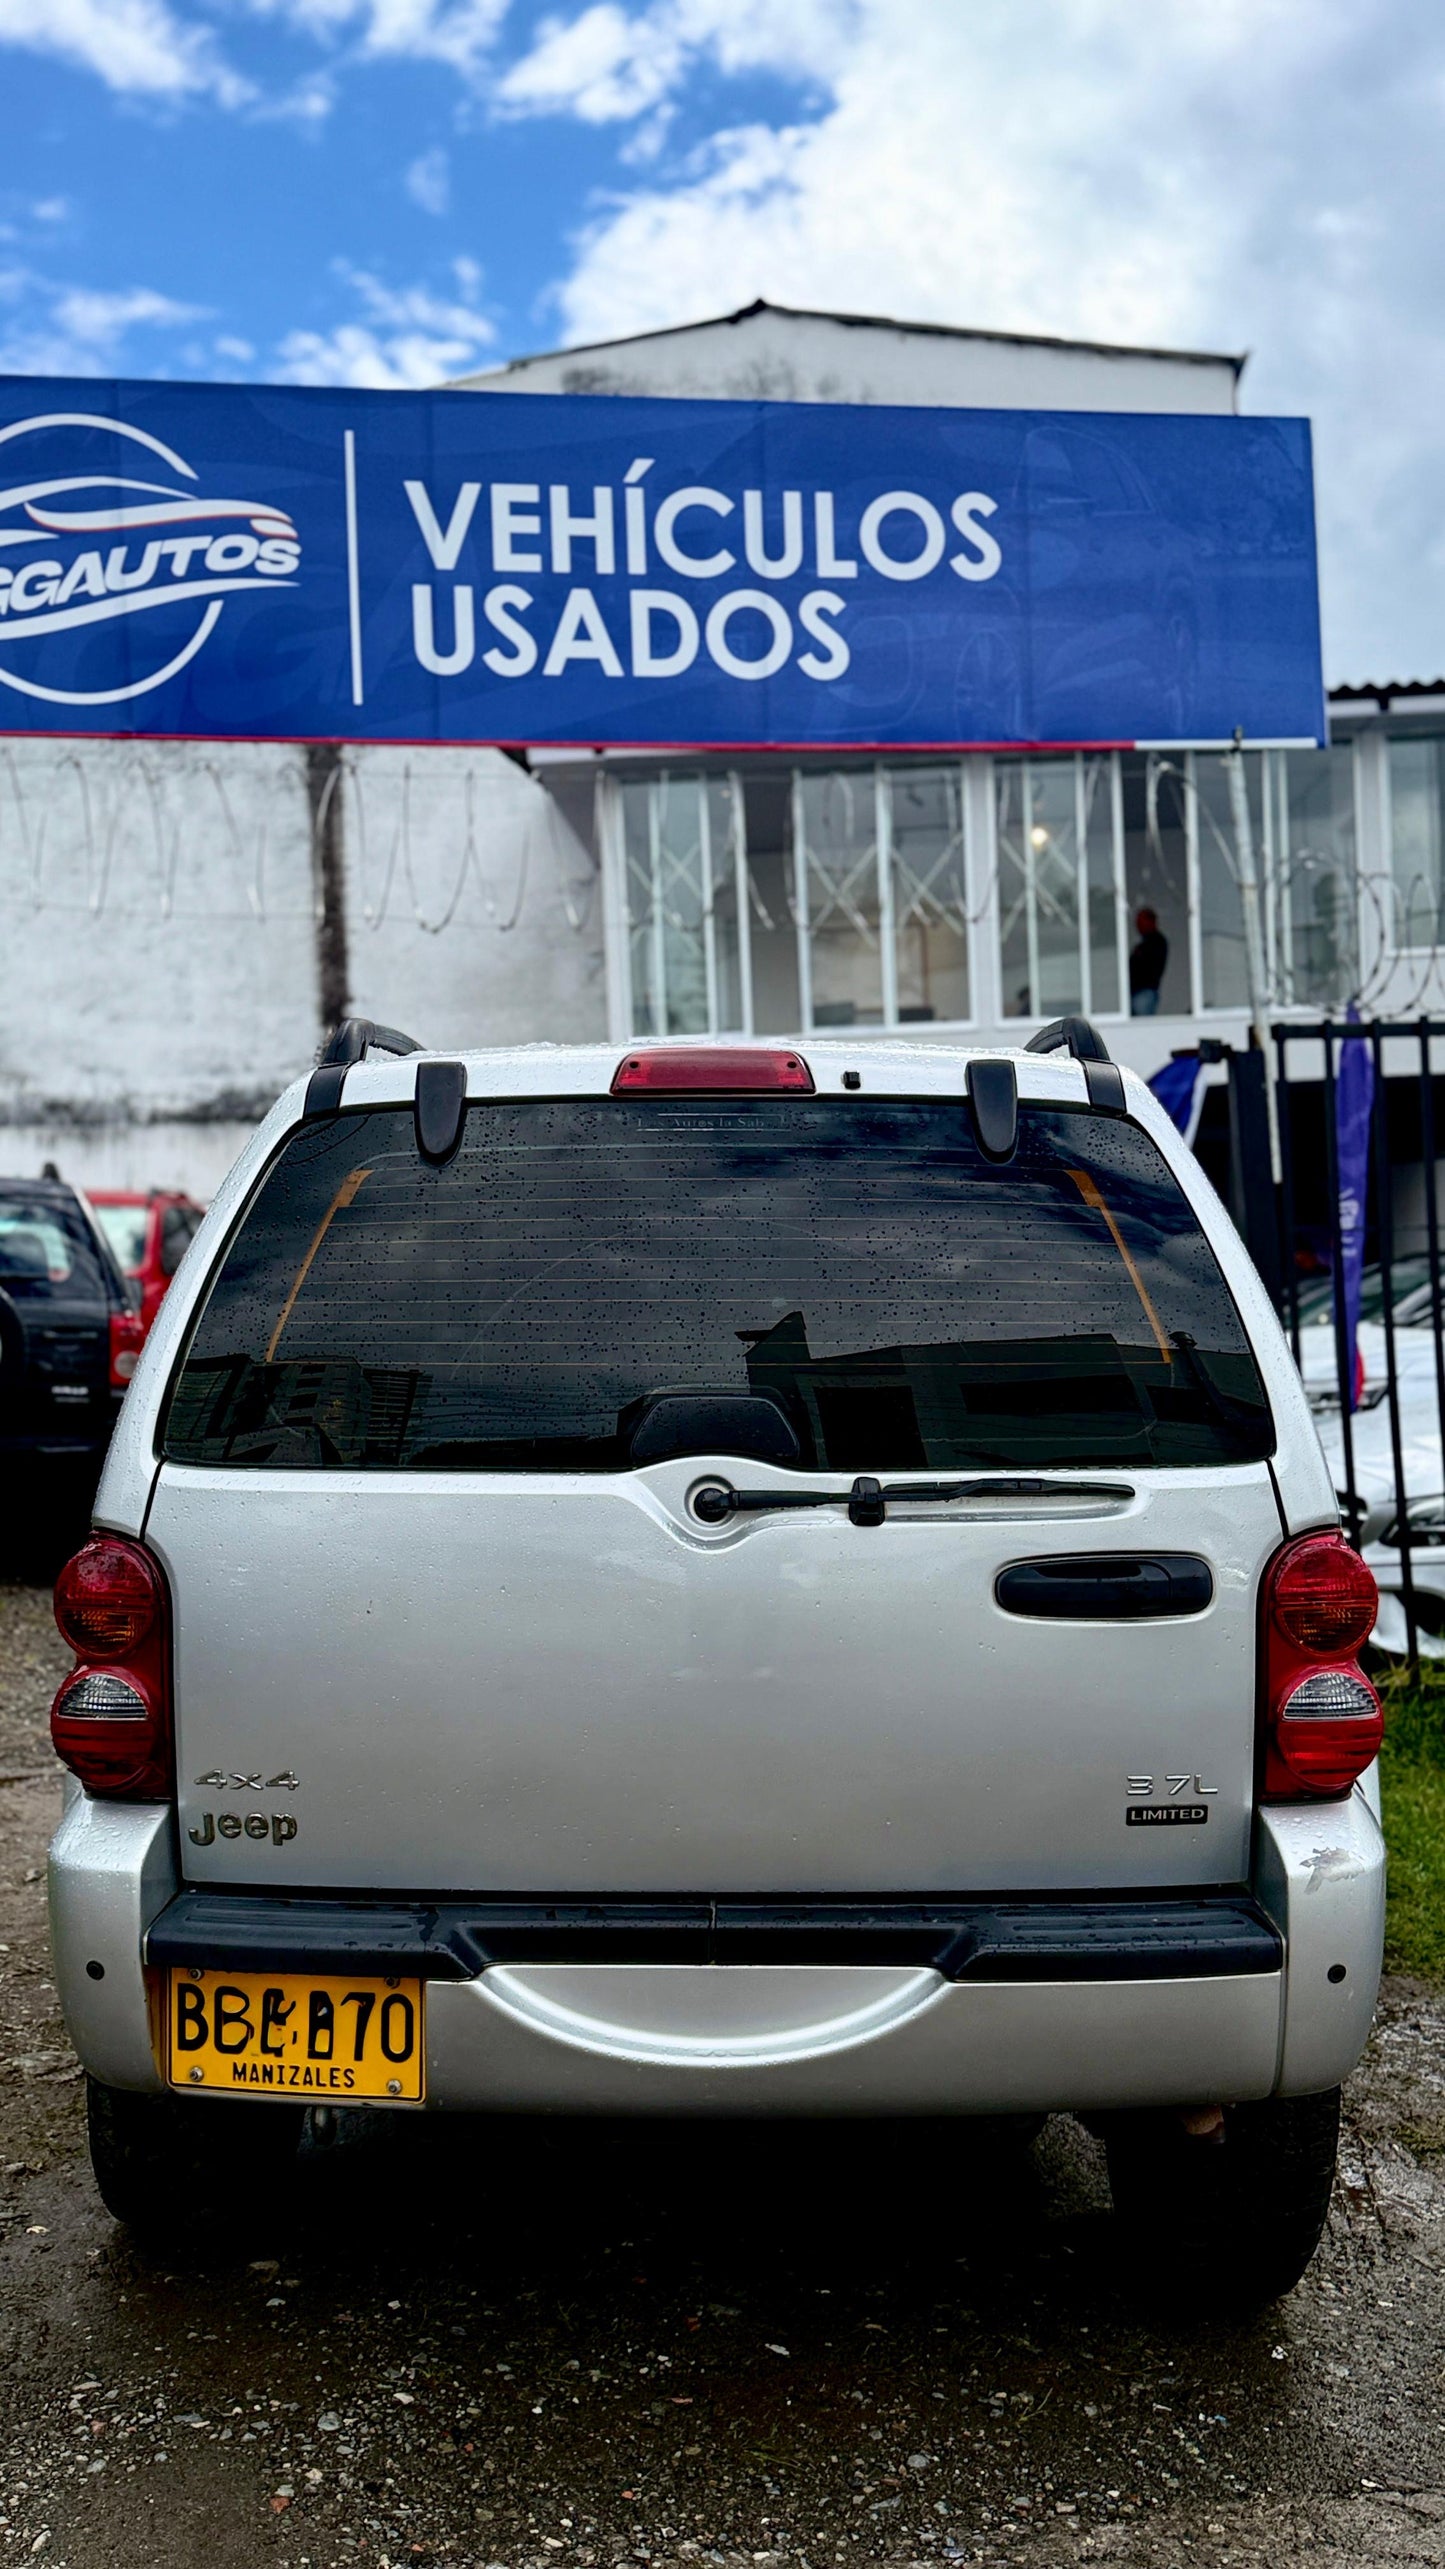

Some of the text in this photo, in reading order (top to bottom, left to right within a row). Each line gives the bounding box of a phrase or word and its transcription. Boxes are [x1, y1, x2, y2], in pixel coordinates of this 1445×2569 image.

[403, 458, 1001, 581] VEHÍCULOS
[0, 534, 302, 615] GAUTOS
[412, 584, 850, 681] USADOS
[194, 1769, 300, 1791] 4x4
[188, 1811, 297, 1846] Jeep
[1130, 1808, 1205, 1821] LIMITED
[232, 2061, 356, 2089] MANIZALES
